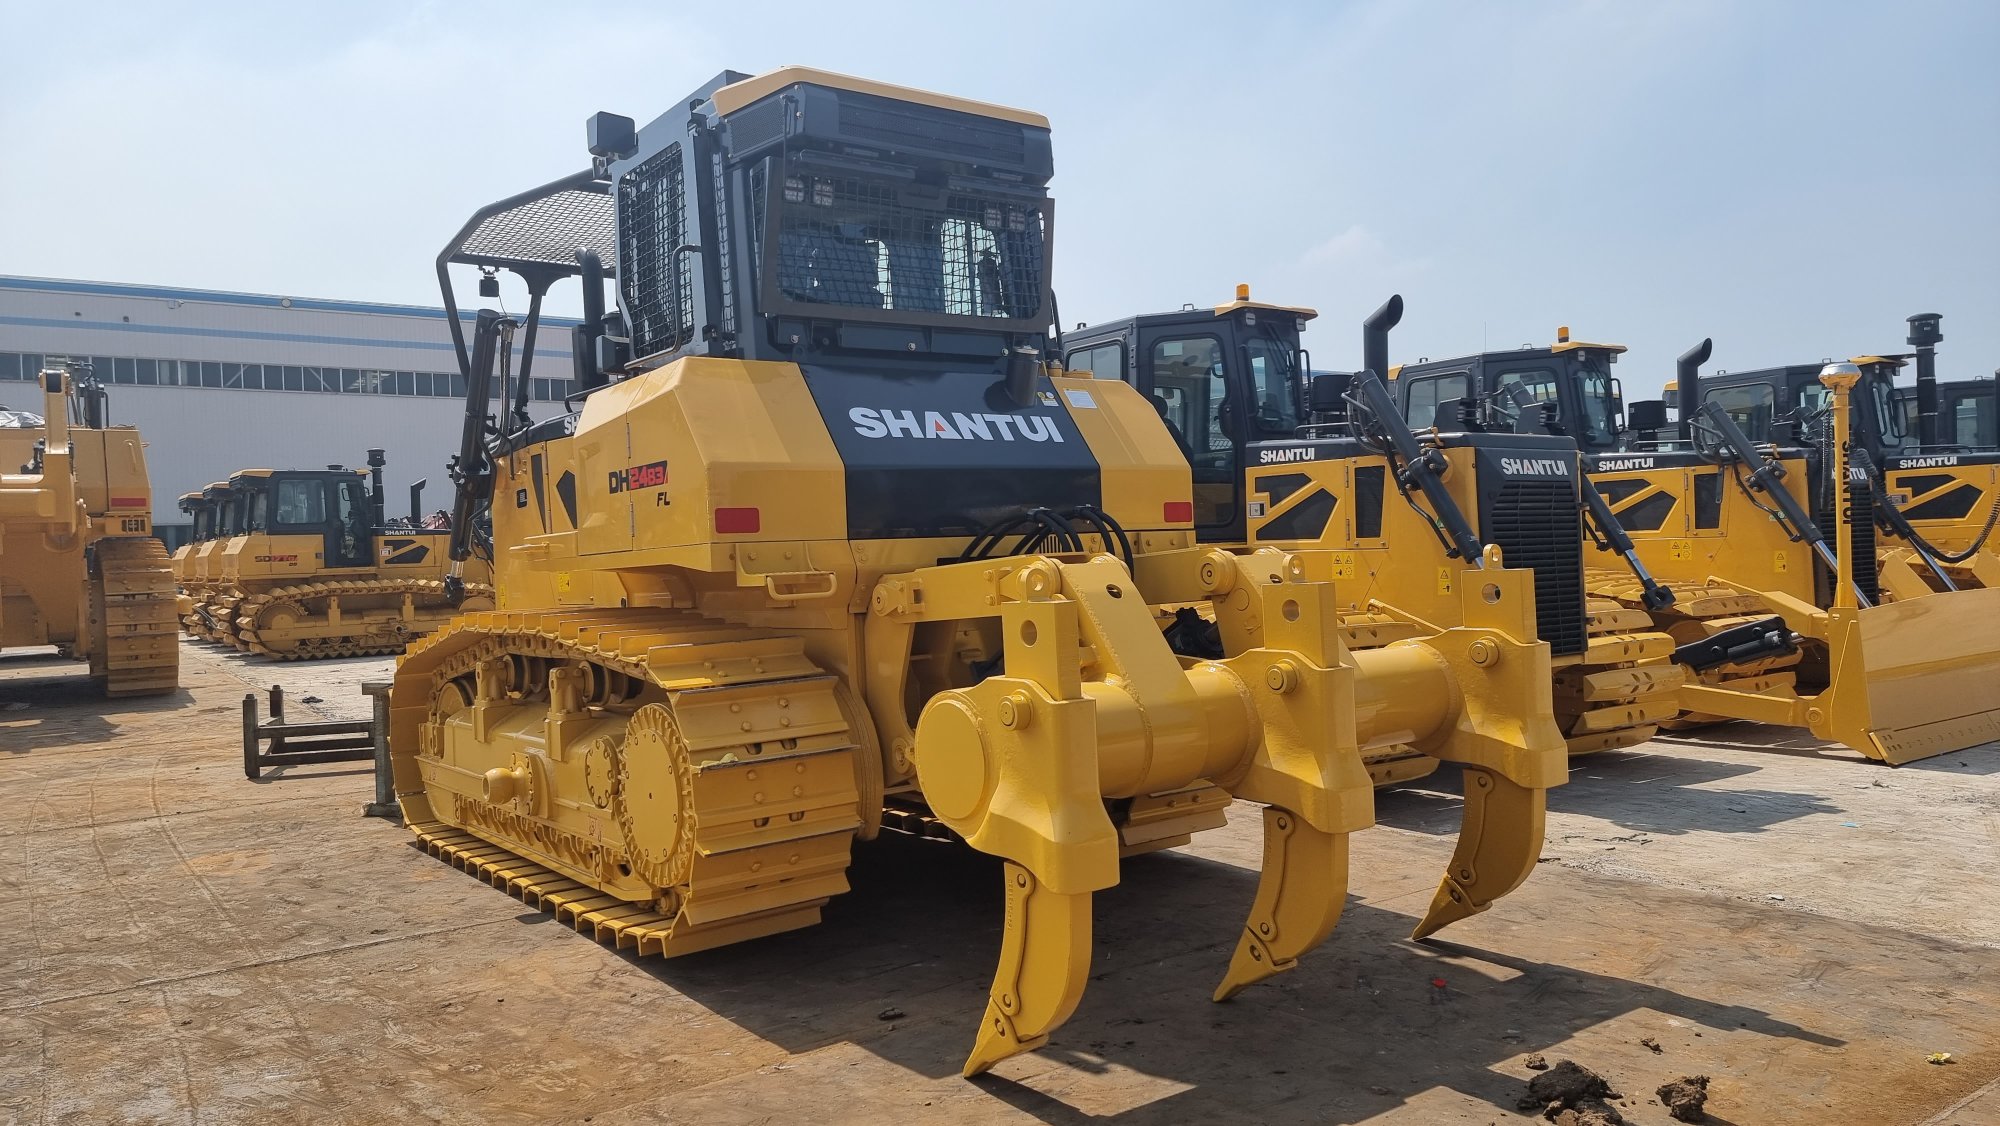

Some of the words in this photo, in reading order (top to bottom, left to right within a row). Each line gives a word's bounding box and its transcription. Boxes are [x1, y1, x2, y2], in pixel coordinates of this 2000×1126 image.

[848, 406, 1065, 443] SHANTUI
[1260, 448, 1315, 463] SHANTUI
[1900, 456, 1957, 469] SHANTUI
[1500, 457, 1568, 476] SHANTUI
[1598, 457, 1654, 472] SHANTUI
[657, 491, 671, 507] FL
